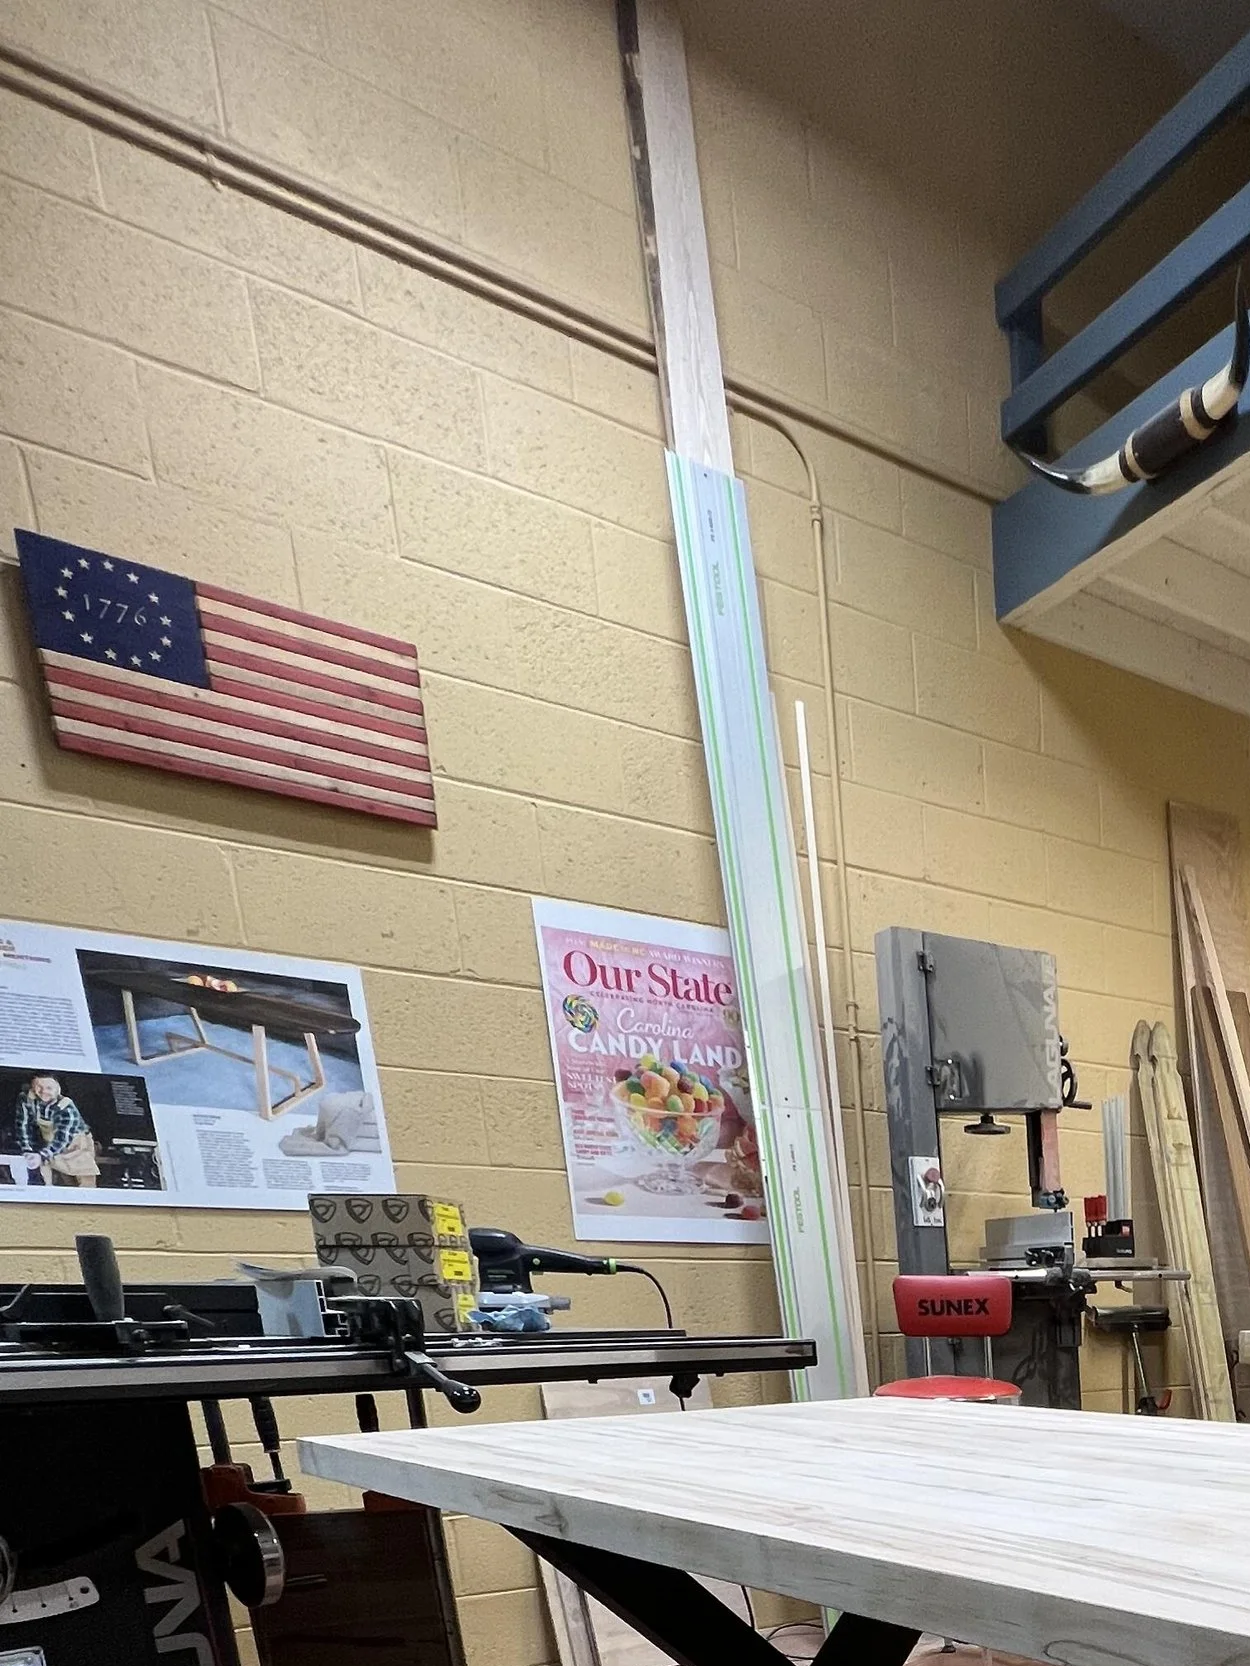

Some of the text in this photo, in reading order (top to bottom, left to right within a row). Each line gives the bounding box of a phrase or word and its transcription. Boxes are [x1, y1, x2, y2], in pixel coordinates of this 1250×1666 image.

[83, 593, 147, 627] 1776
[563, 950, 733, 1007] Our State
[616, 1007, 694, 1039] Carolina
[568, 1028, 742, 1070] CANDY LAND
[1042, 985, 1063, 1107] LAGUNA
[918, 1298, 990, 1316] SUNEX
